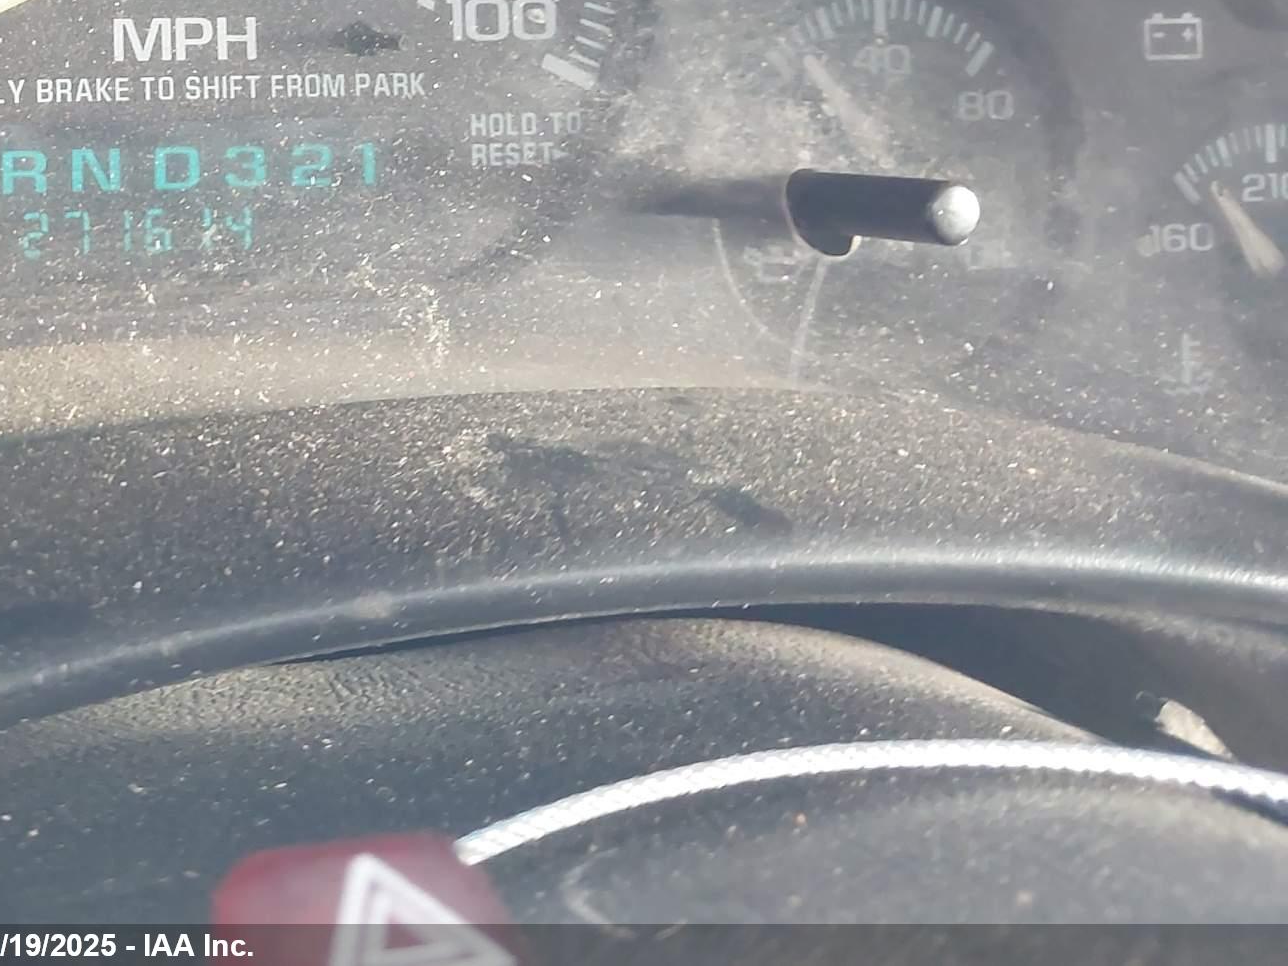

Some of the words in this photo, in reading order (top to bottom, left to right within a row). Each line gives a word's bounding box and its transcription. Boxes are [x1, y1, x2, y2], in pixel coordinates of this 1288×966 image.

[112, 16, 258, 62] MPH
[36, 76, 130, 104] BRAKE
[140, 75, 175, 101] TO
[185, 74, 260, 100] SHIFT
[271, 73, 346, 98] FROM
[355, 72, 427, 98] PARK
[470, 111, 537, 136] HOLD
[549, 111, 582, 135] TO
[2, 150, 47, 195] R
[72, 147, 120, 192] N
[224, 144, 267, 188] 3
[291, 143, 333, 187] 2
[470, 141, 554, 166] RESET
[1241, 172, 1288, 202] 21
